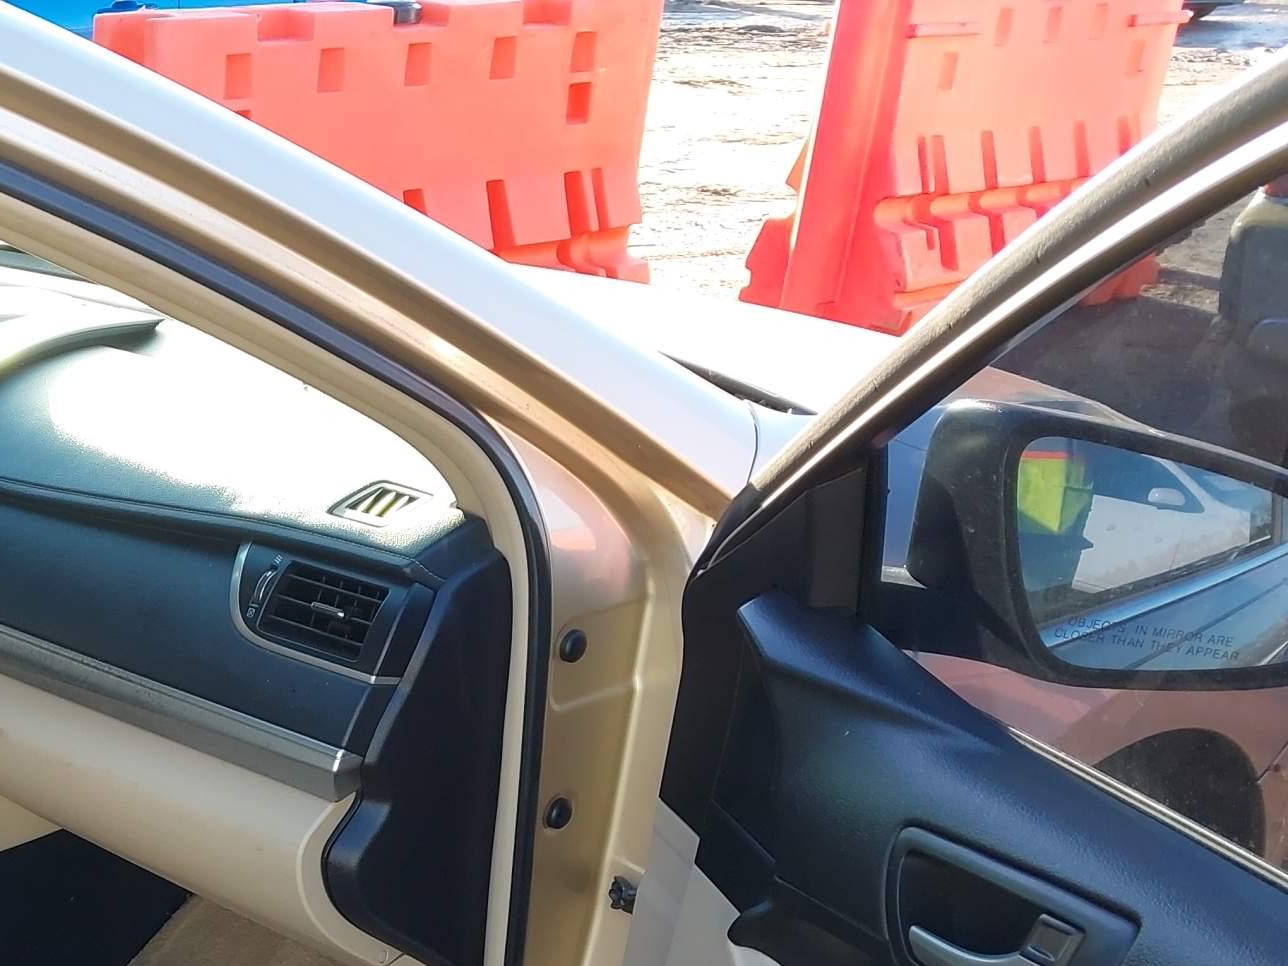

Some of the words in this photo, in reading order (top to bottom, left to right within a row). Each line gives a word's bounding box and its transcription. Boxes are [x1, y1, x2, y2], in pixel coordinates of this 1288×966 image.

[1068, 616, 1126, 633] OBJECS
[1135, 624, 1147, 636] IN
[1152, 627, 1203, 642] MIRROR
[1207, 634, 1234, 647] ARE
[1111, 635, 1144, 648] THAN
[1151, 640, 1184, 654] THEY
[1185, 646, 1240, 661] APPEAR
